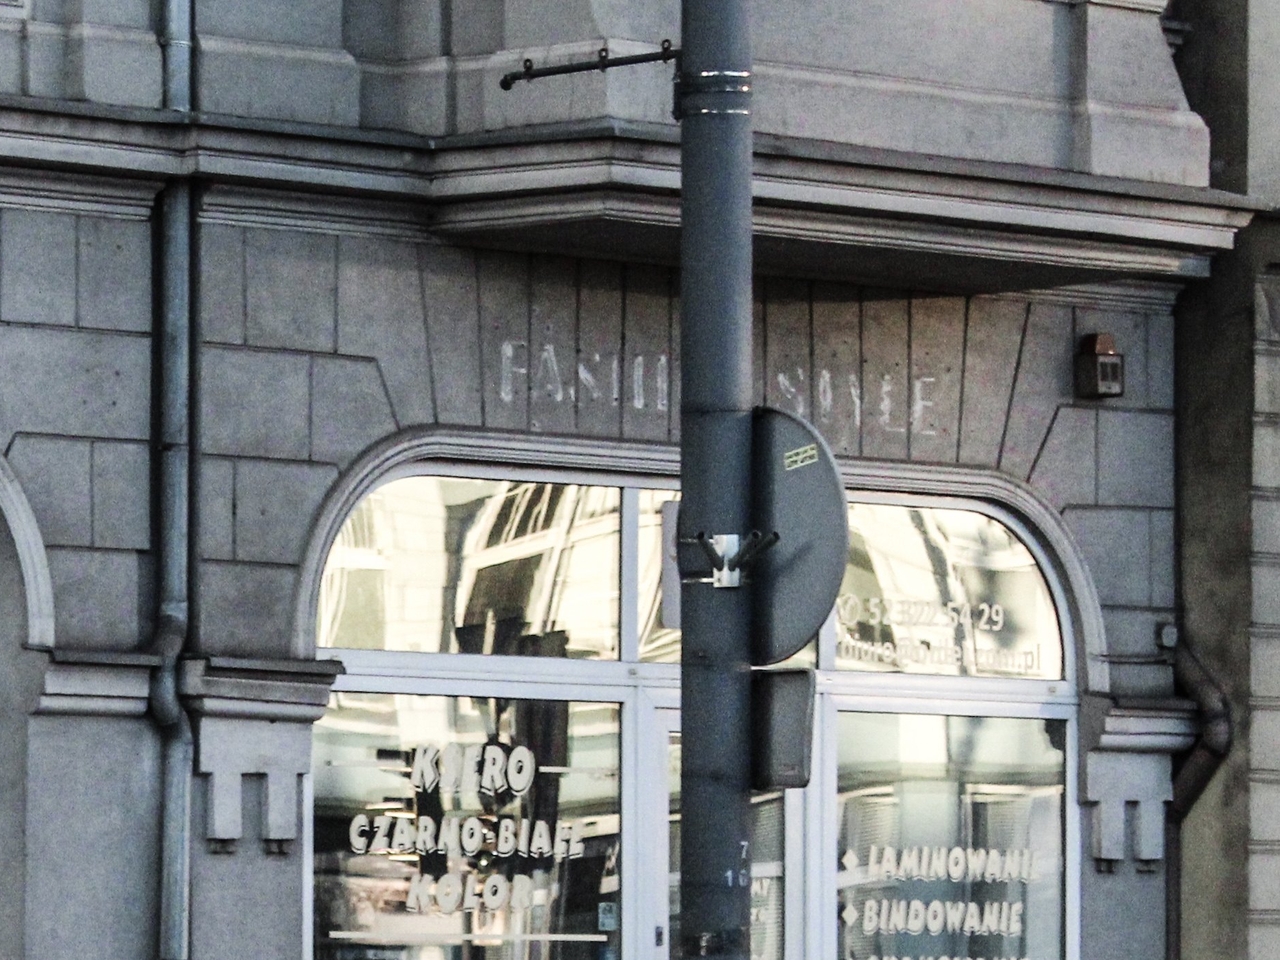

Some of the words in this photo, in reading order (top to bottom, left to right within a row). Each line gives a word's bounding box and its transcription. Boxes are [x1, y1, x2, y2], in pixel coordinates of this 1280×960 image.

[947, 602, 972, 627] 54
[978, 603, 1005, 631] 29
[410, 744, 536, 797] KSERO
[867, 845, 1043, 883] LAMINOWANIE
[406, 873, 533, 915] KOLOR
[863, 899, 1024, 937] BINDOWANIE
